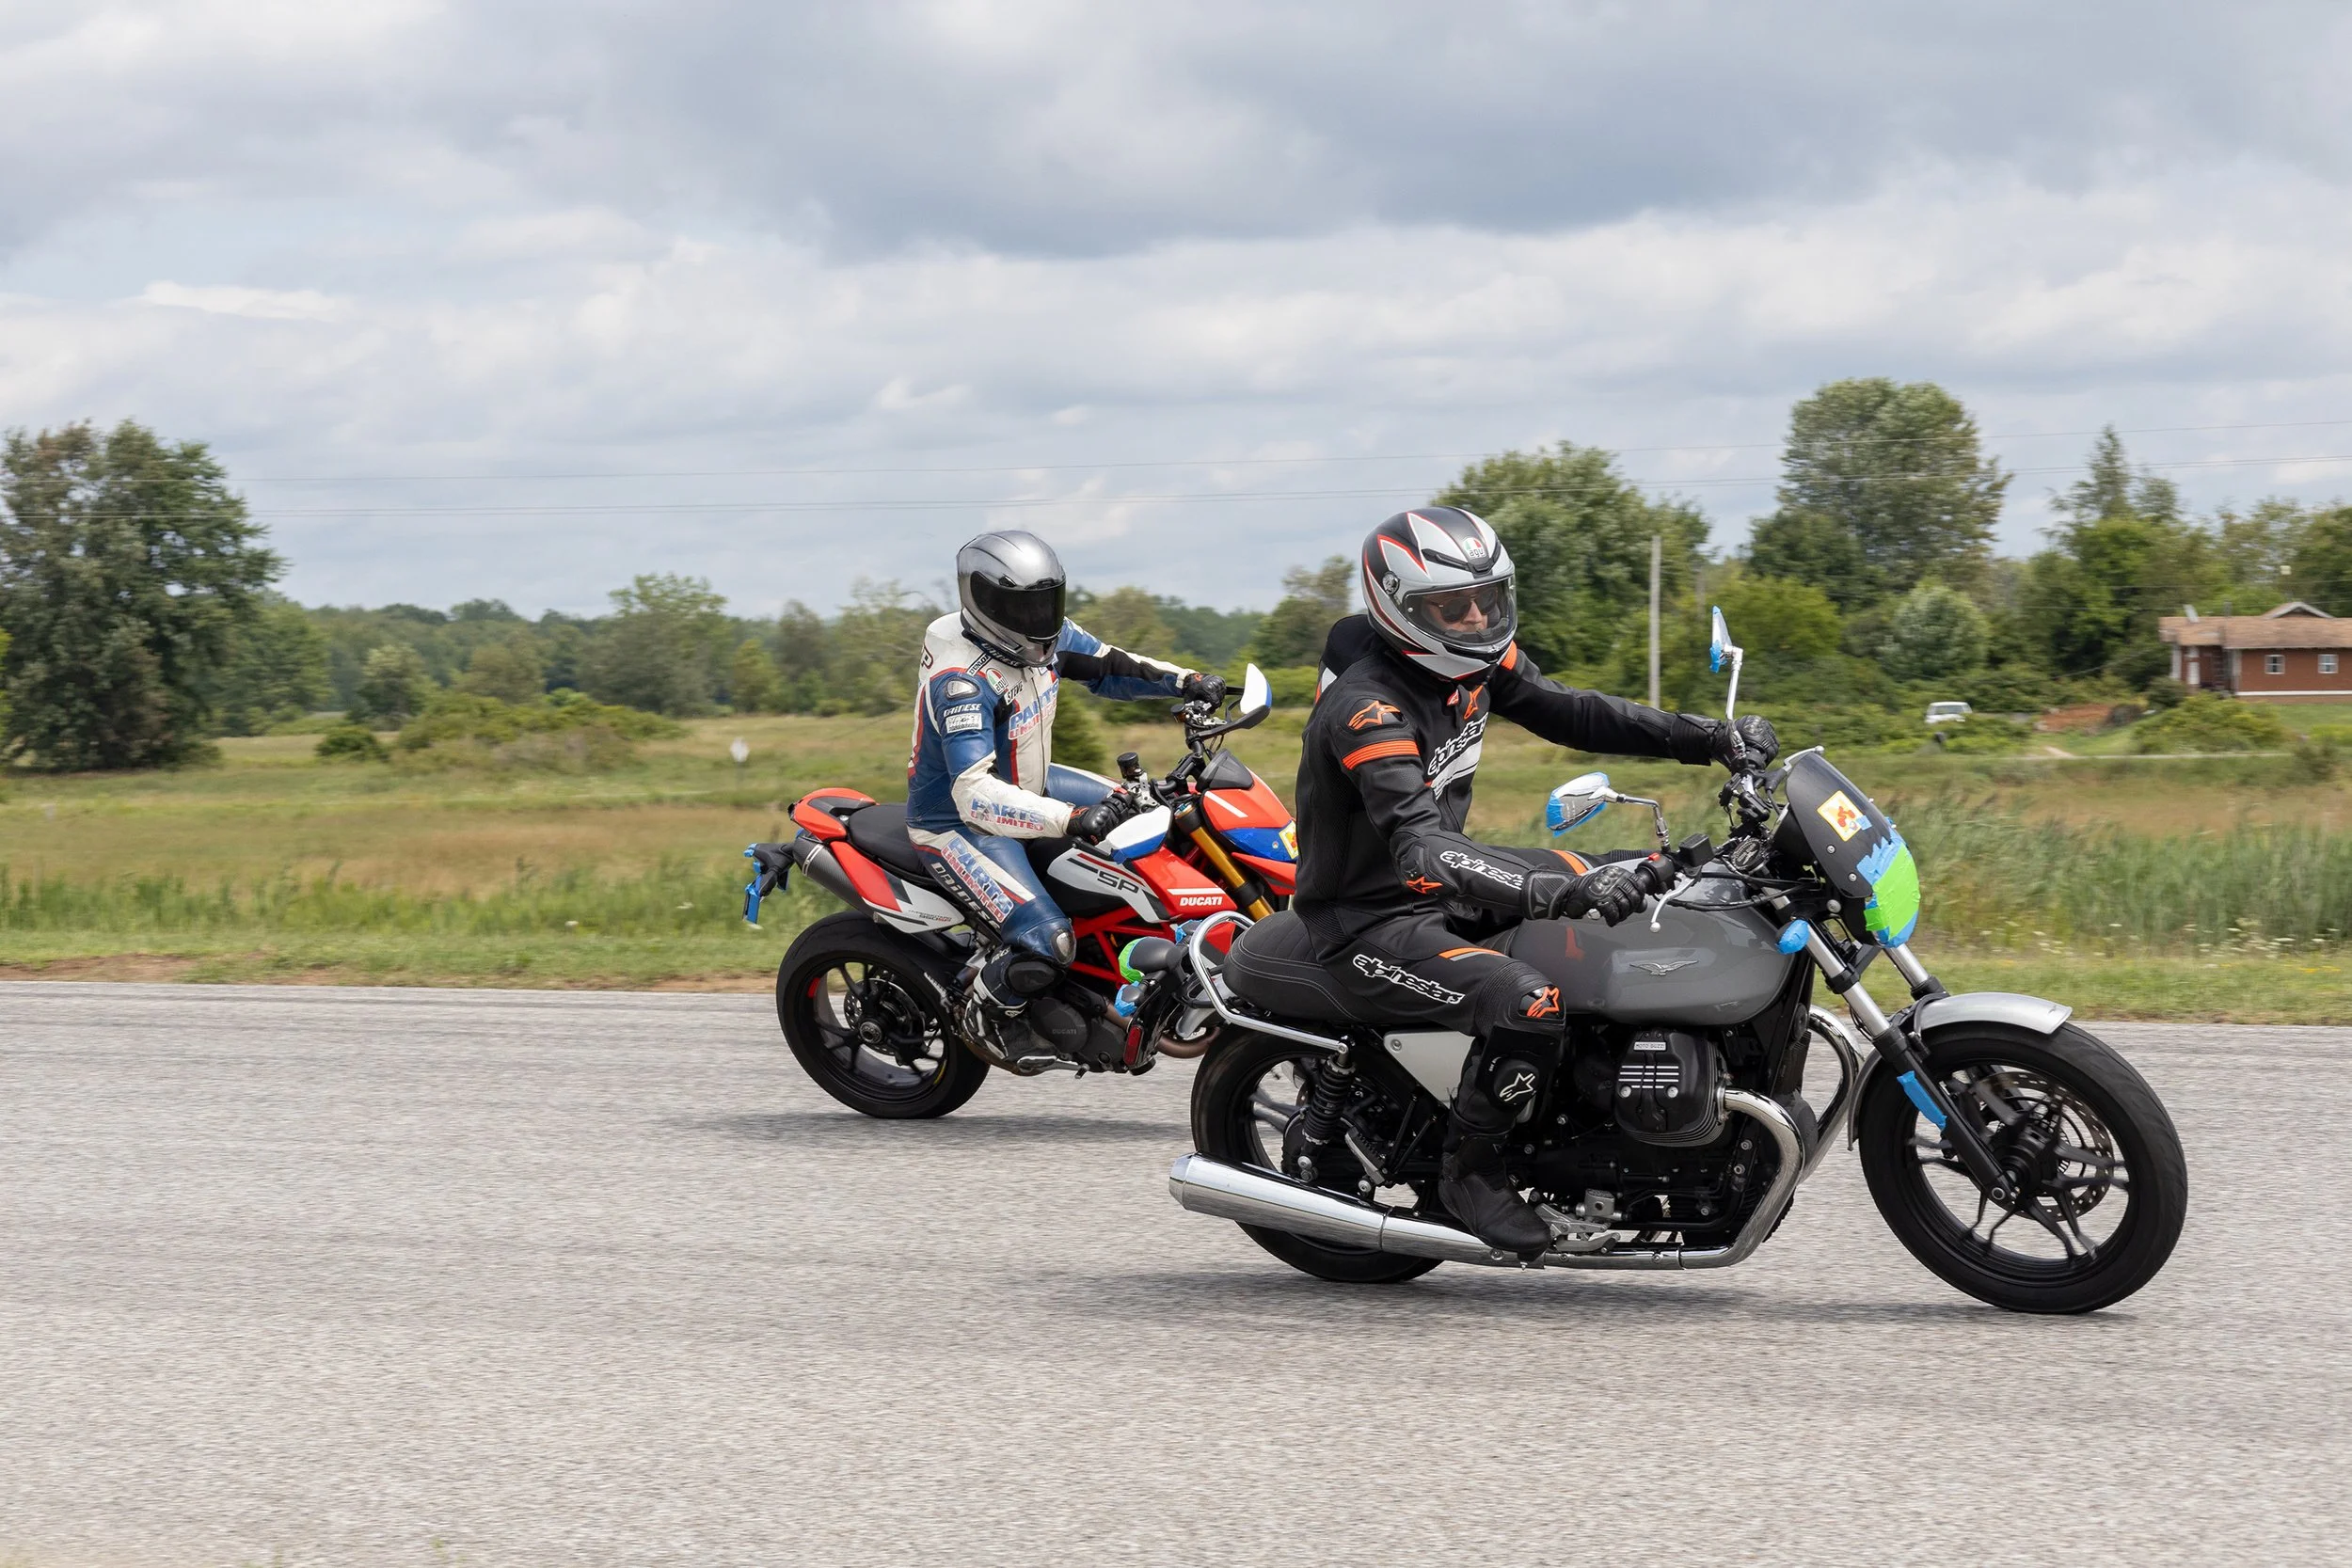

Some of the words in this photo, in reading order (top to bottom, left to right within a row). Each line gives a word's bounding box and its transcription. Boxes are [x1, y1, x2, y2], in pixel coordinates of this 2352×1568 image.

[1006, 681, 1024, 704] STEVE
[1010, 678, 1059, 731] PARTS
[1428, 711, 1488, 776] alpinesta
[971, 798, 1044, 825] PARTS
[941, 846, 1006, 923] UNLIMITED
[947, 836, 1014, 917] PARTS
[1097, 870, 1139, 894] SP
[1439, 850, 1524, 891] alpinesta
[1180, 896, 1223, 906] DUCATI
[1352, 954, 1466, 1005] alpinestars
